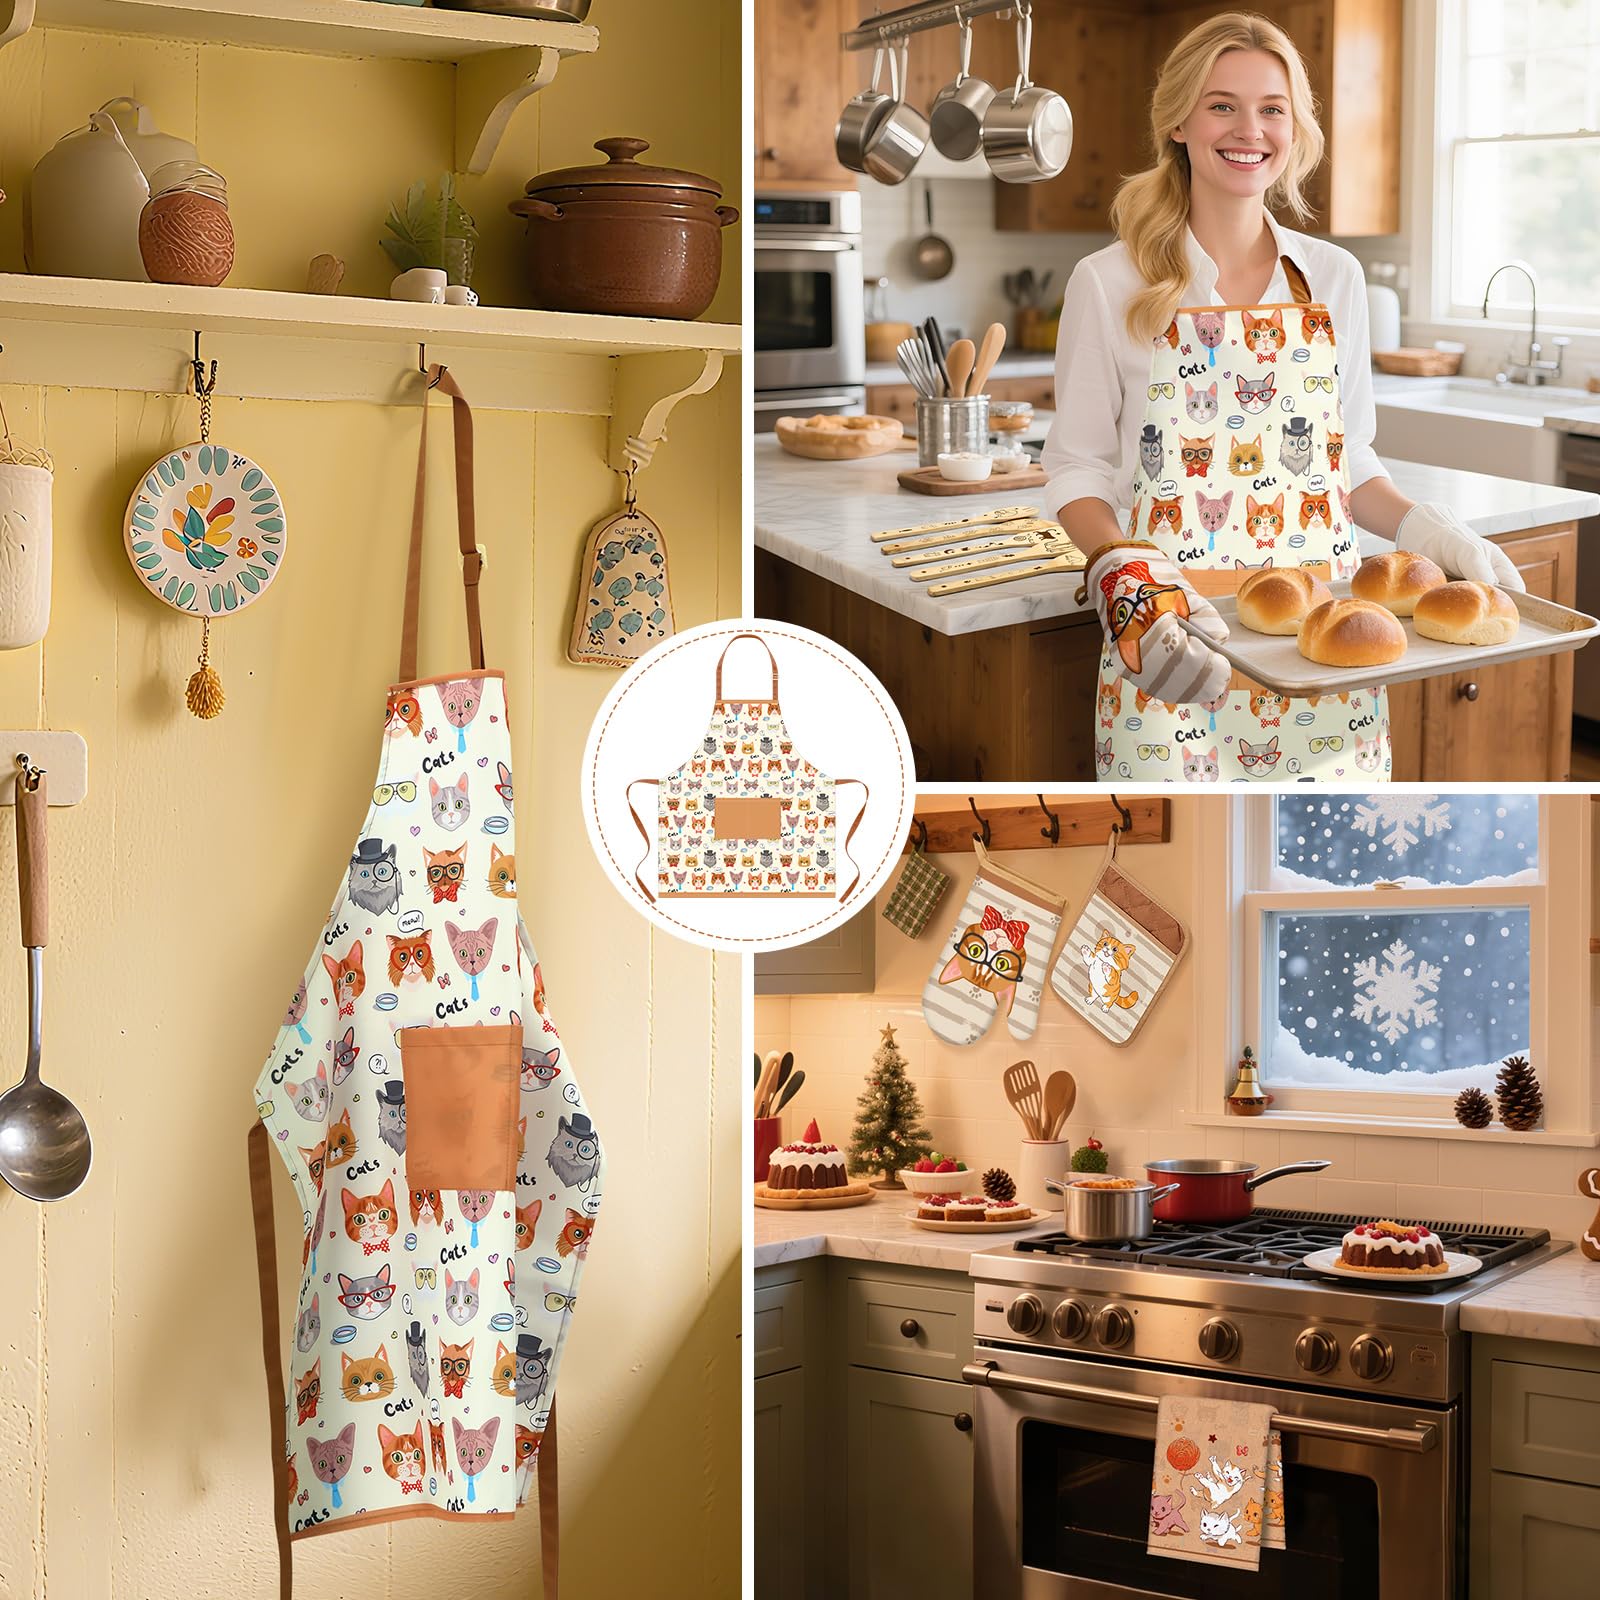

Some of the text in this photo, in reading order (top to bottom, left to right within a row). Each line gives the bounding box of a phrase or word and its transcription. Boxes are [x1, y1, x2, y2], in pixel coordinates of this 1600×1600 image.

[1178, 362, 1207, 379] Cats
[1252, 476, 1277, 491] Cats
[1177, 547, 1206, 563] Cats
[1102, 658, 1114, 670] Cat
[1348, 713, 1375, 732] Cats
[1174, 727, 1207, 743] Cats
[422, 751, 455, 774] Cats
[324, 921, 350, 946] Cats
[435, 997, 469, 1020] Cats
[270, 1047, 304, 1084] Cats
[346, 1158, 381, 1181] Cats
[515, 1172, 537, 1186] ats
[440, 1244, 468, 1264] Cats
[383, 1398, 414, 1417] Cats
[446, 1495, 465, 1512] Cats
[294, 1507, 331, 1532] Cats
